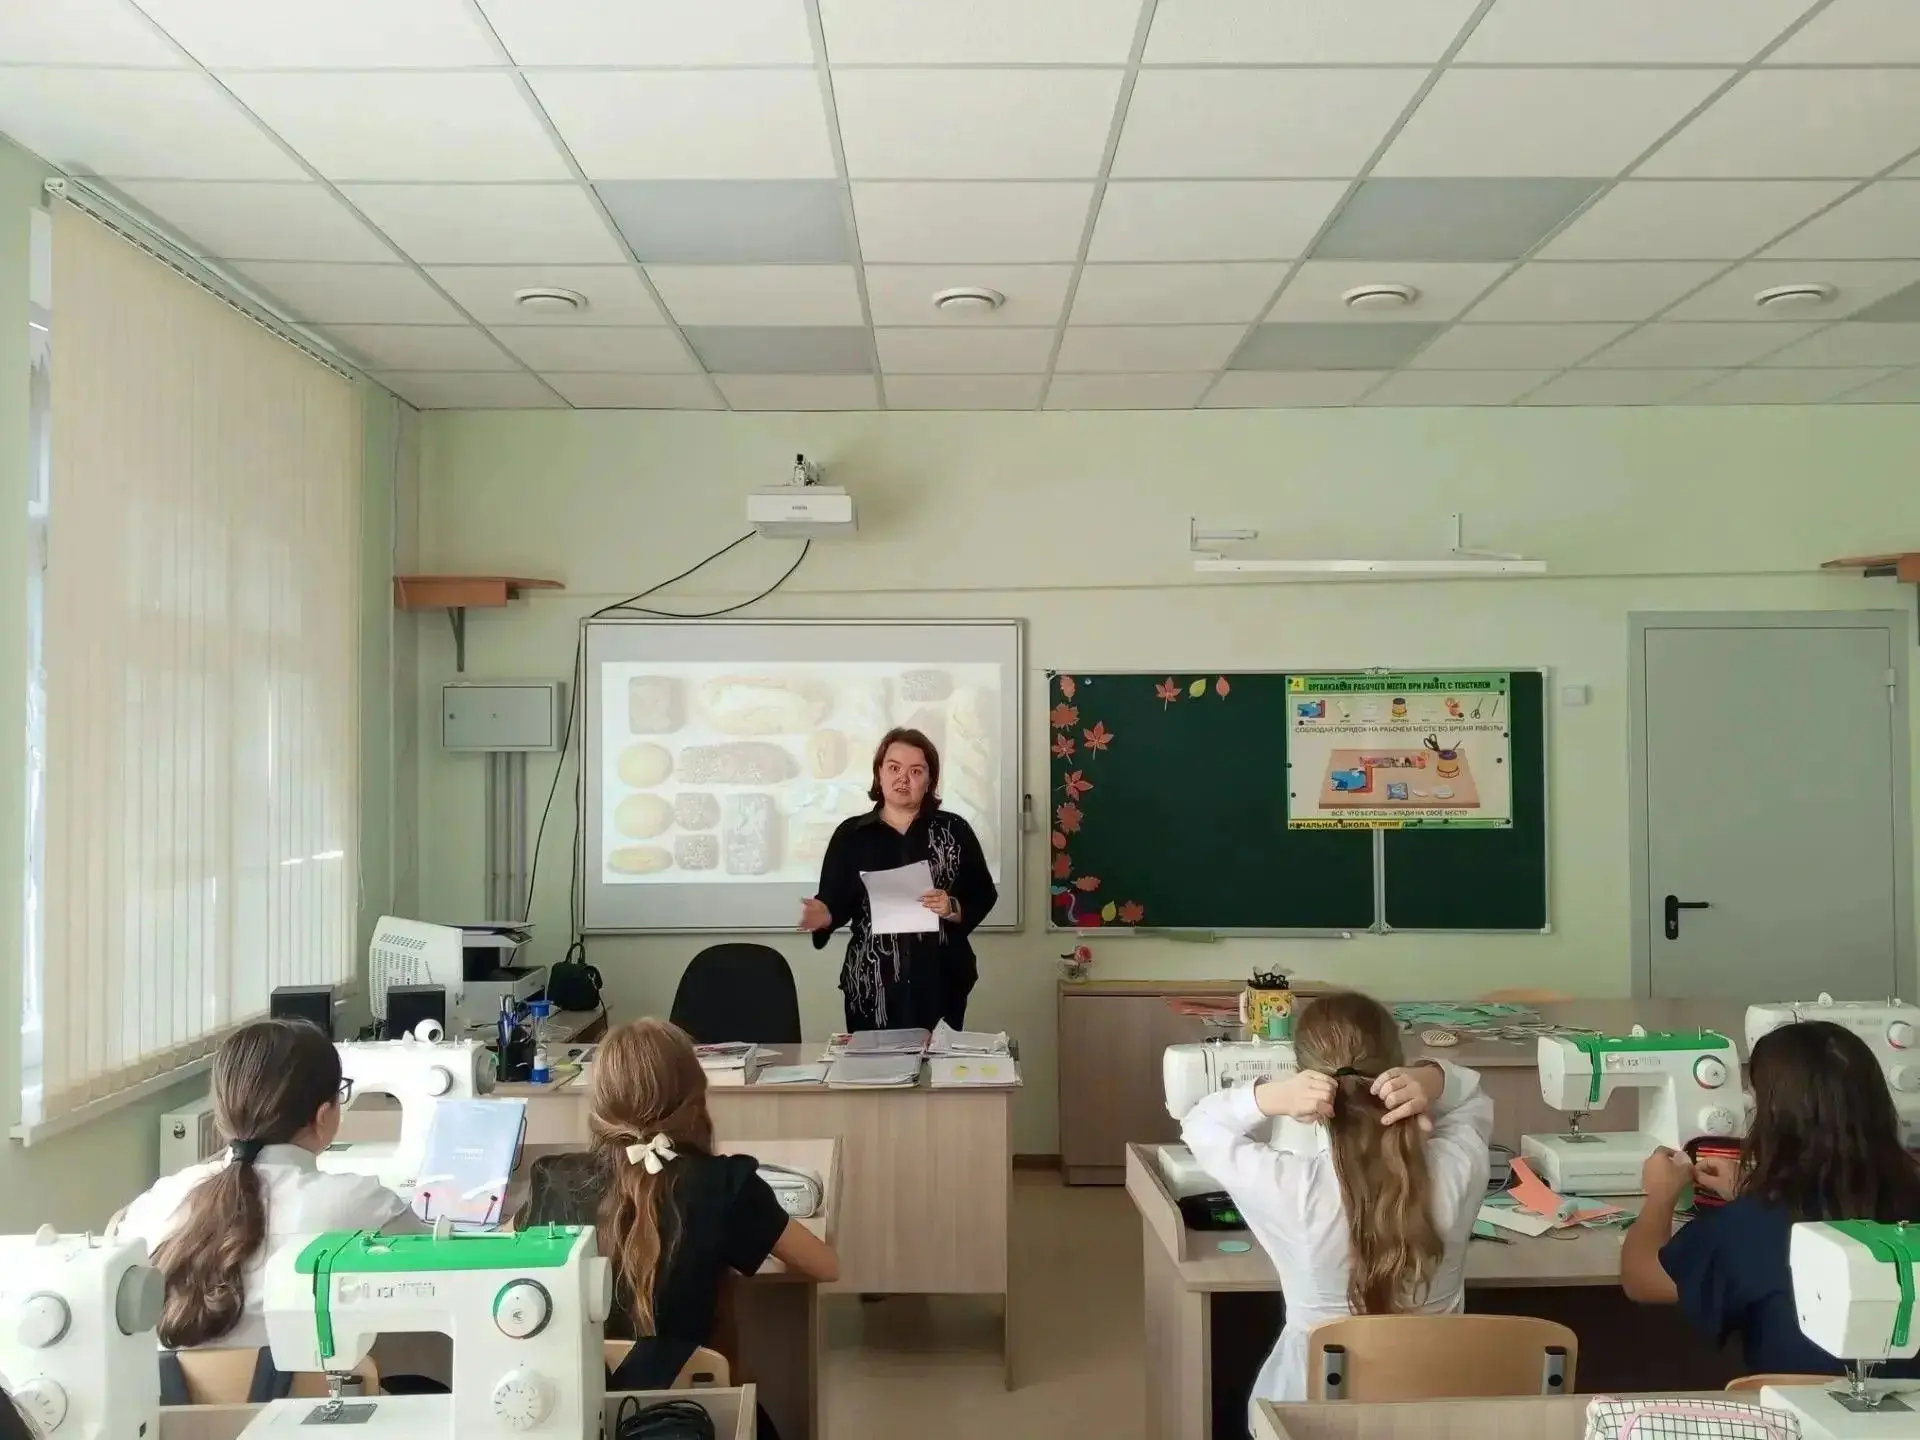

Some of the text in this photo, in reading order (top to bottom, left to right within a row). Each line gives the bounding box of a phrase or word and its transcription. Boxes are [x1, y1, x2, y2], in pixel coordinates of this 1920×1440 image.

[1308, 683, 1352, 691] ОРГАНИЗАЯ
[1353, 683, 1385, 691] РАБОЧЕГО
[1387, 682, 1407, 690] МЕСТА
[1408, 682, 1421, 690] ПРИ
[1423, 682, 1446, 690] РАБОТЕ
[1455, 681, 1491, 689] ТЕКСТИЛЕМ
[1335, 725, 1366, 734] ПОРЯДОК
[1380, 725, 1411, 733] РАБОЧЕМ
